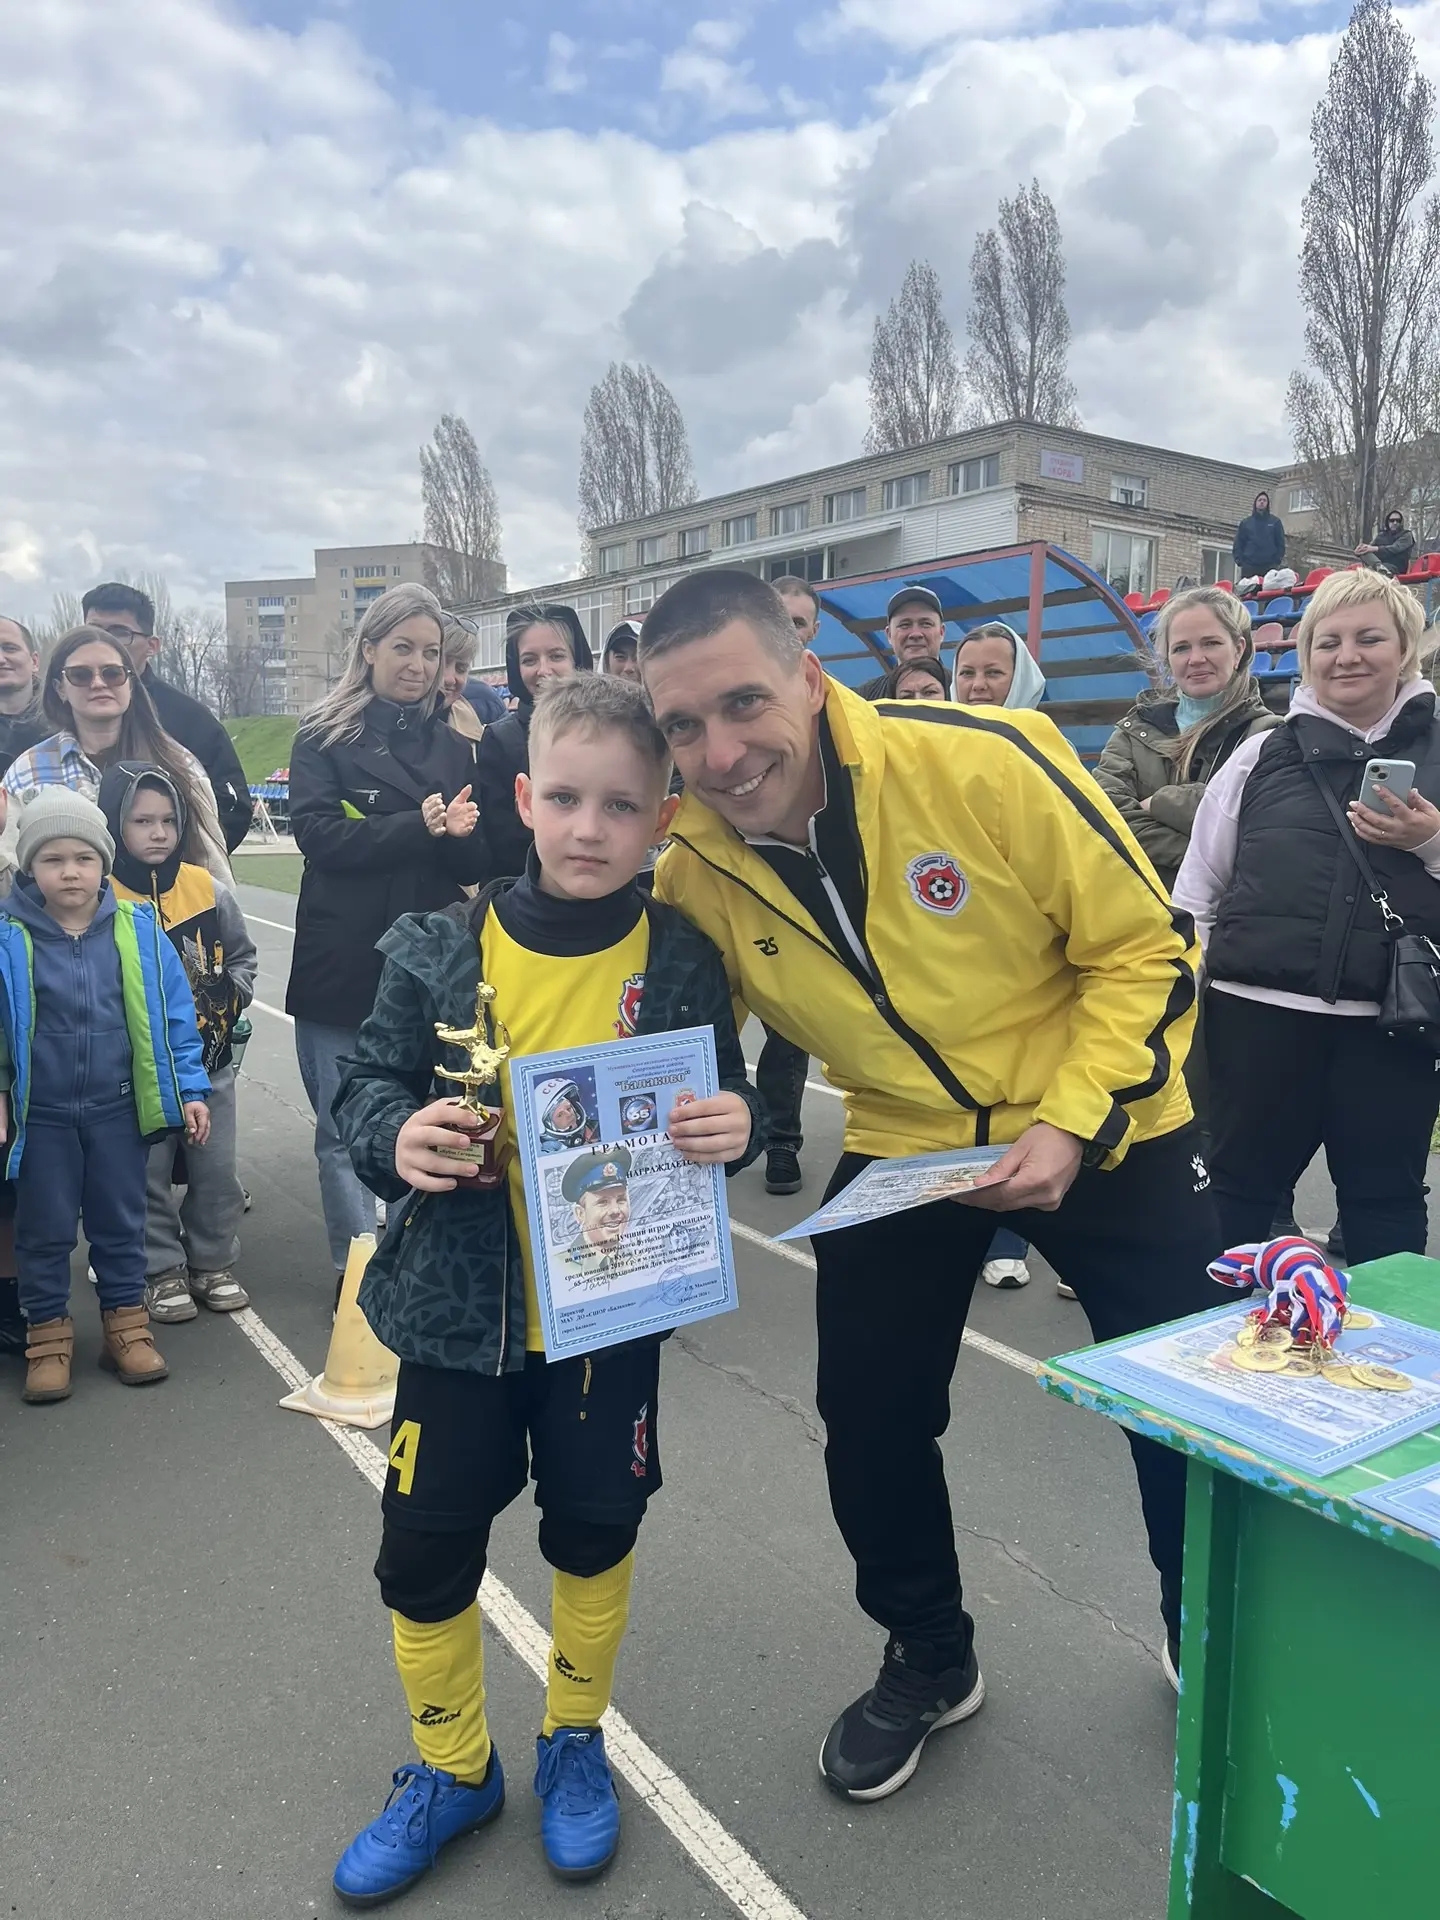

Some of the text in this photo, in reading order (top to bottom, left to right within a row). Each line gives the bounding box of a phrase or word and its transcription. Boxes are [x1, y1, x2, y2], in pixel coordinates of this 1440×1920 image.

[631, 1109, 650, 1120] 65
[591, 1132, 671, 1156] ГРАМОТА
[1193, 1174, 1211, 1193] KEL
[648, 1223, 671, 1234] игрок
